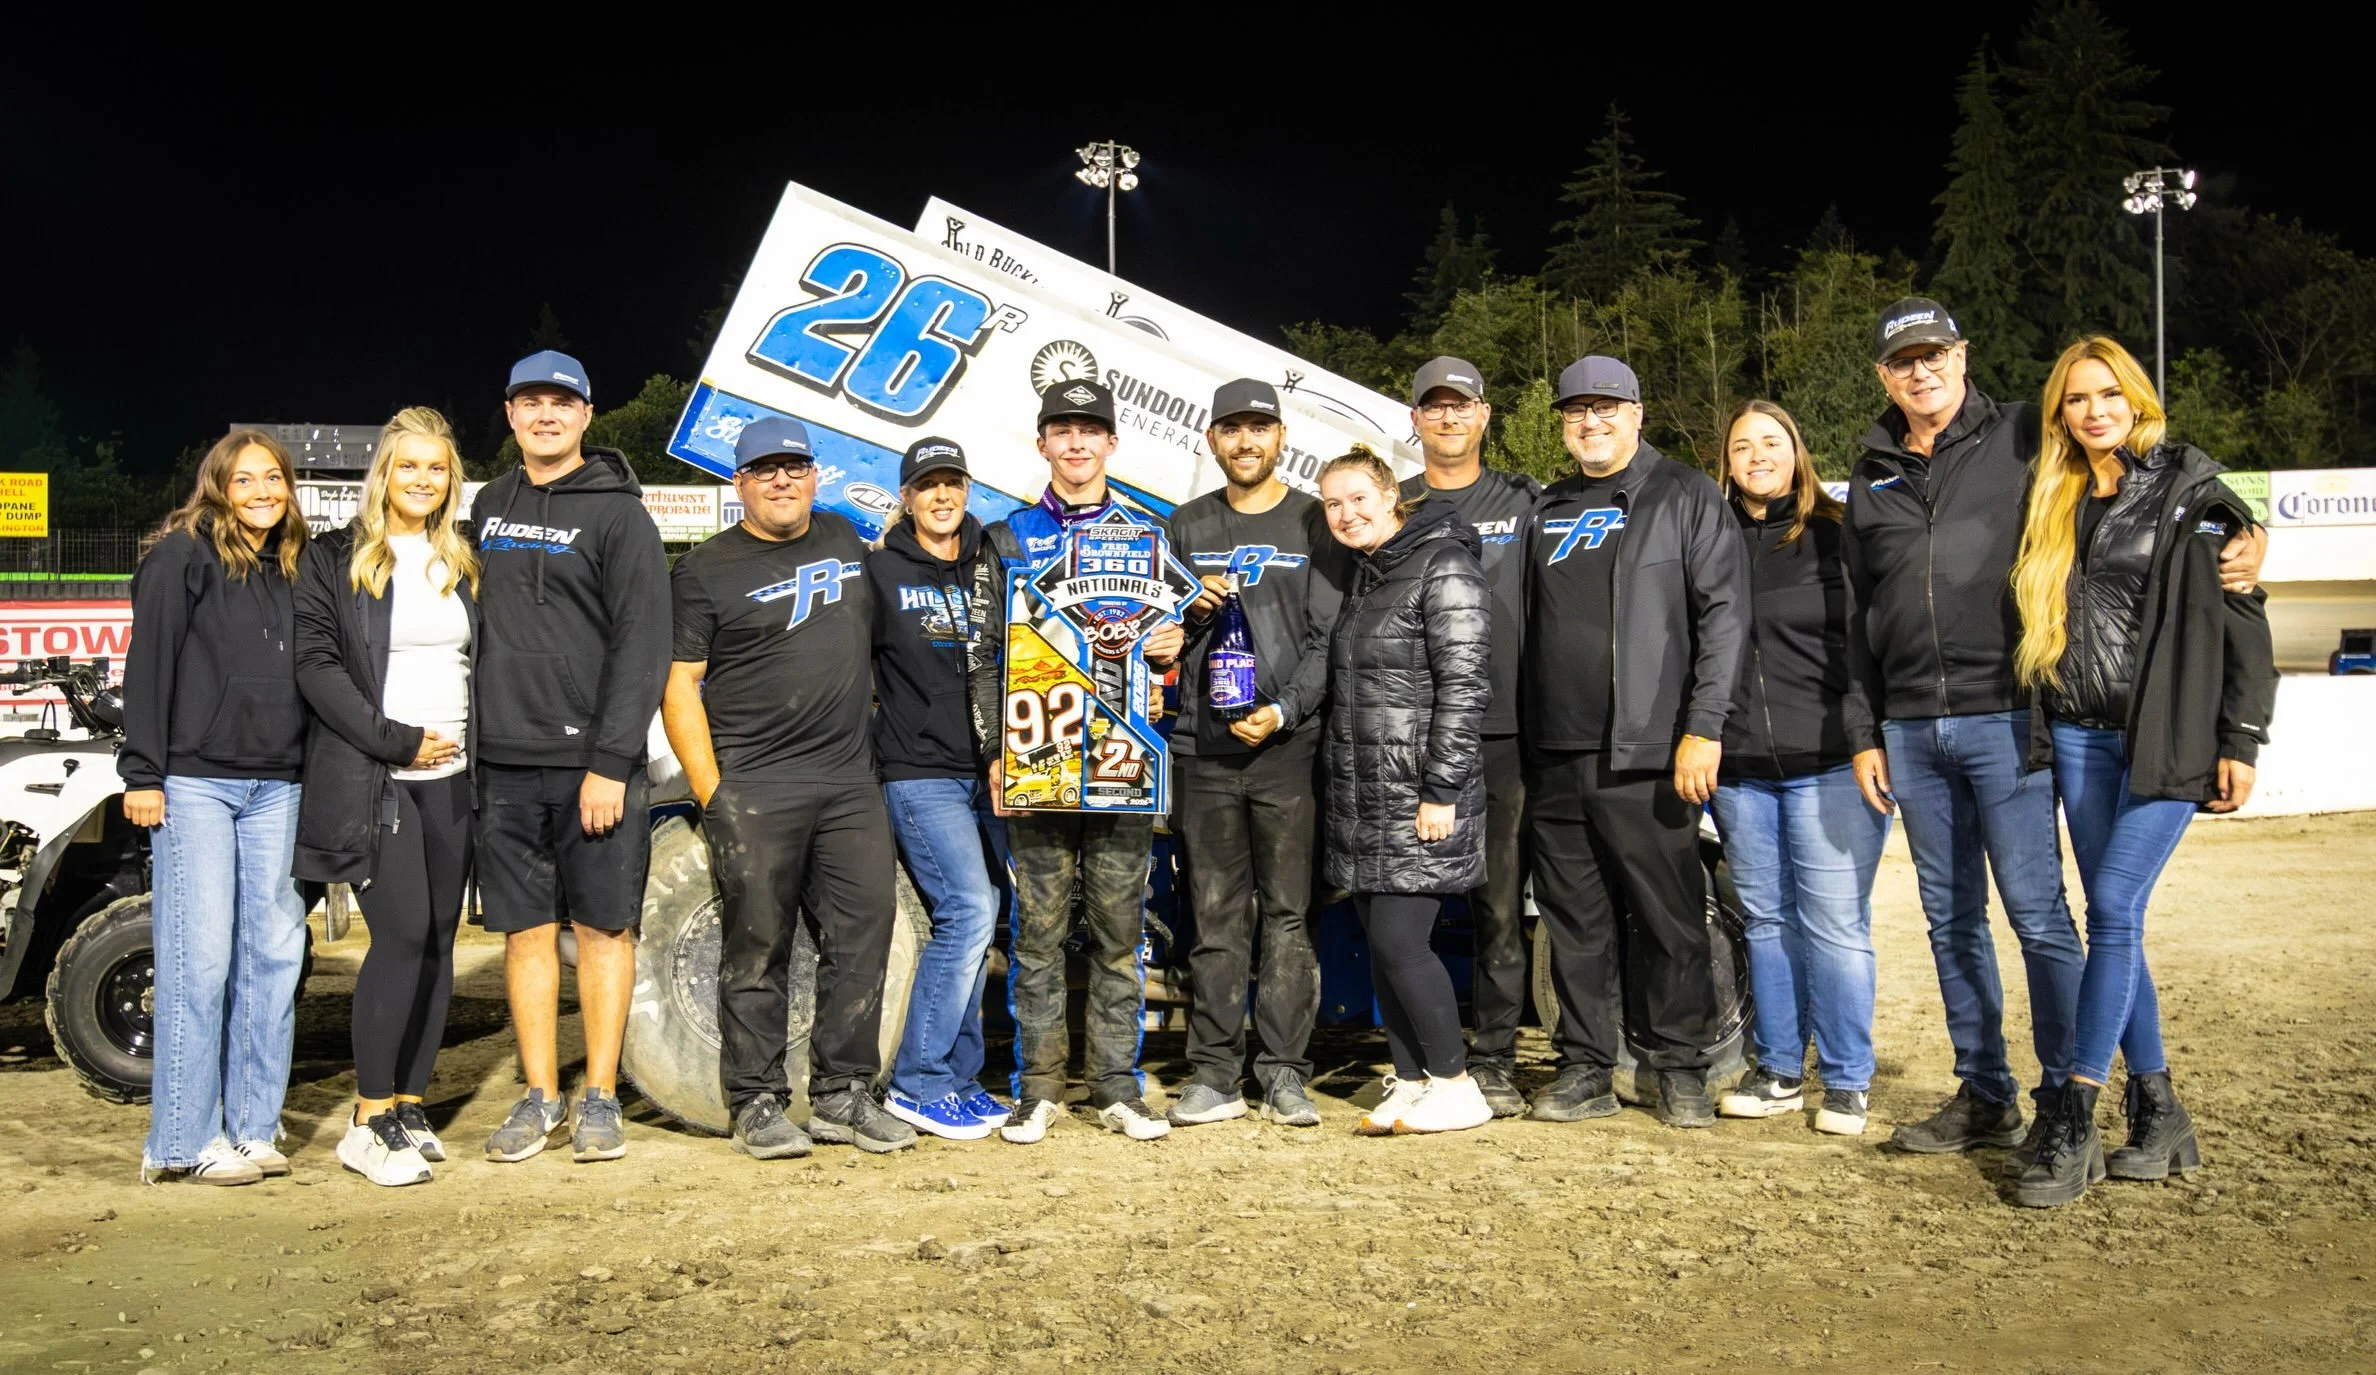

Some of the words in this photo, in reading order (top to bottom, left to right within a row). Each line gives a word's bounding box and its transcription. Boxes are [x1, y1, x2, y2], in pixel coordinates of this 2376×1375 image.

[745, 242, 996, 427] 26
[975, 303, 1029, 334] R
[1114, 402, 1201, 456] ENERAL
[10, 479, 43, 487] ROAD
[2278, 491, 2376, 520] Coron
[6, 512, 42, 521] DUMP
[481, 516, 582, 545] RUDEEN
[1091, 527, 1143, 538] SKAGIT
[1080, 544, 1151, 559] BROWNFIELD
[1102, 543, 1130, 551] FRED
[1081, 558, 1149, 576] 360
[1066, 578, 1162, 599] NATIONALS
[1109, 608, 1126, 619] 1982
[1084, 619, 1141, 645] BOB'S
[1006, 682, 1084, 756] 92
[1095, 740, 1143, 780] 2ND
[1098, 786, 1143, 798] SECOND
